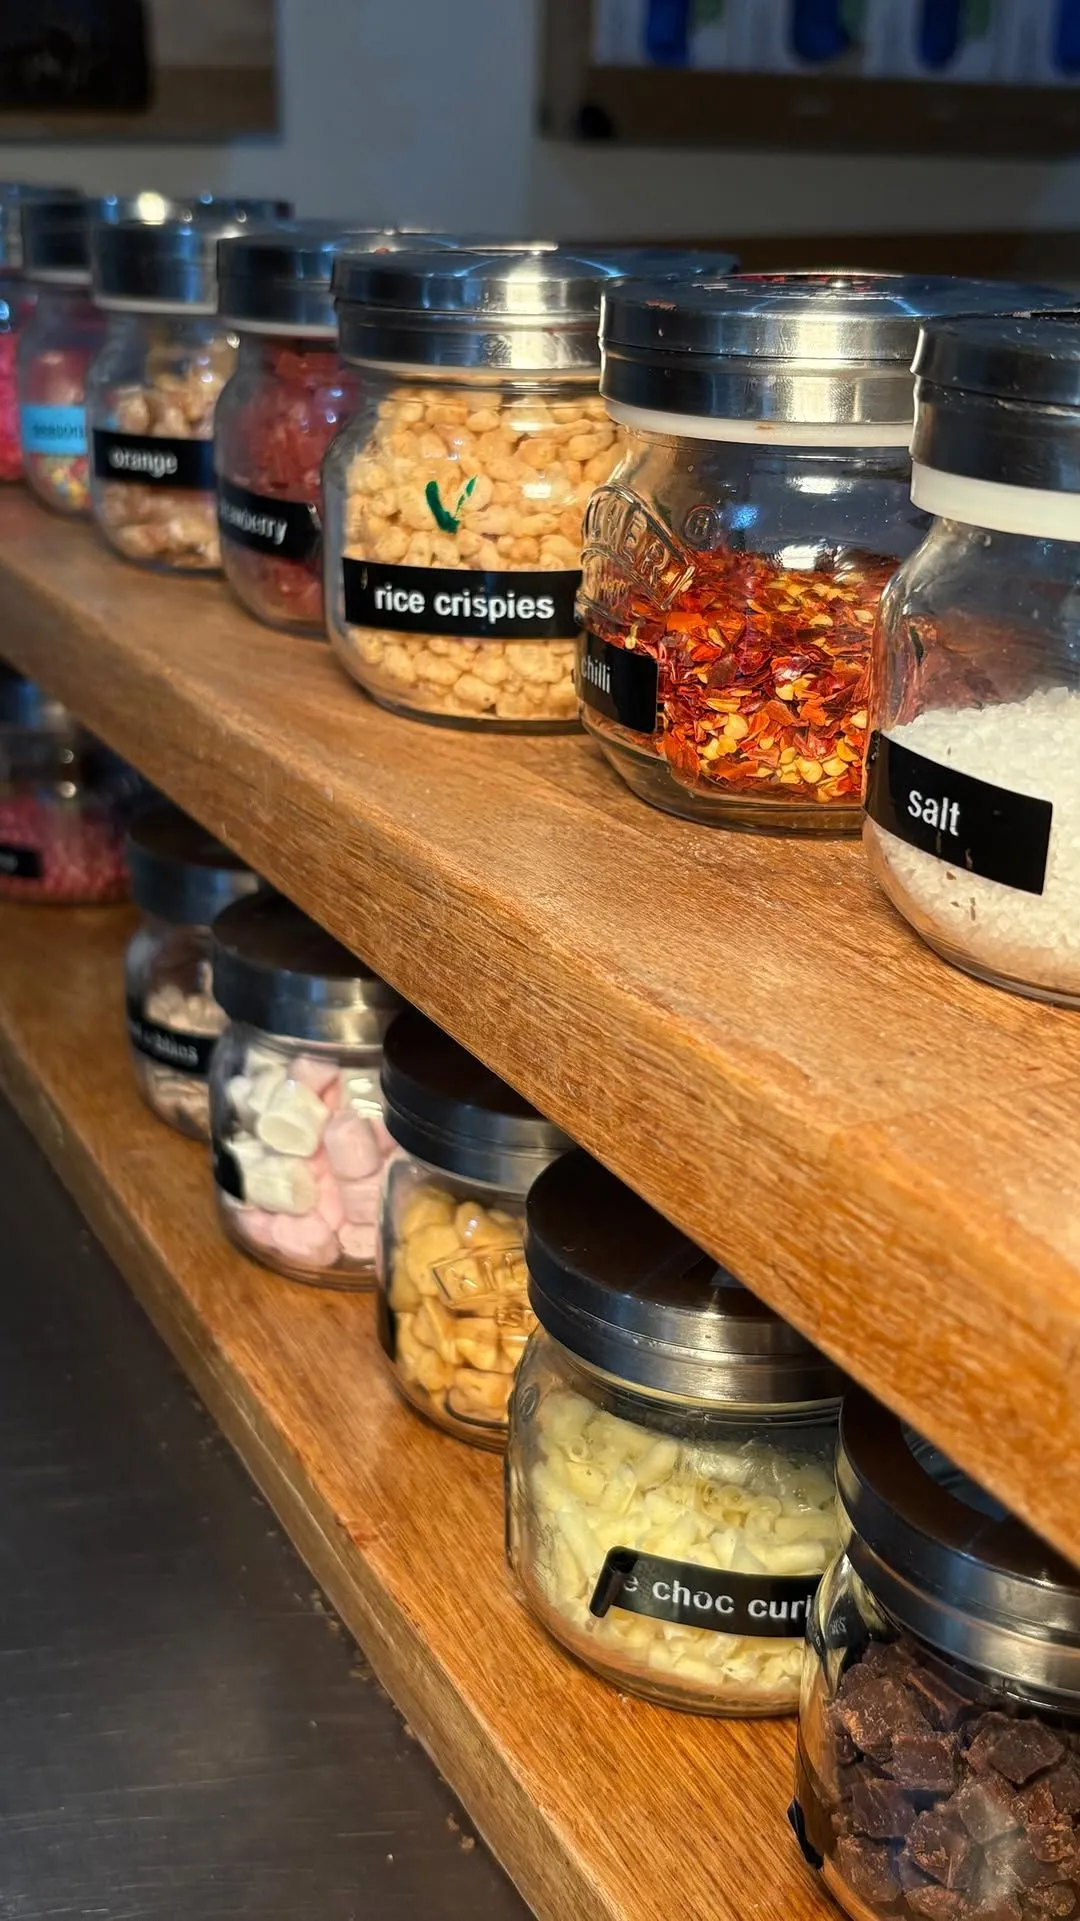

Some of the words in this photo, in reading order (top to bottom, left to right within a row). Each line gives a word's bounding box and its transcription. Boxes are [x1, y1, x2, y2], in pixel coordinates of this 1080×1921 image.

[109, 446, 178, 478] orange
[374, 582, 426, 614] rice
[433, 587, 556, 625] crispies
[580, 654, 611, 695] chilli
[907, 789, 961, 837] salt
[651, 1579, 735, 1614] choc
